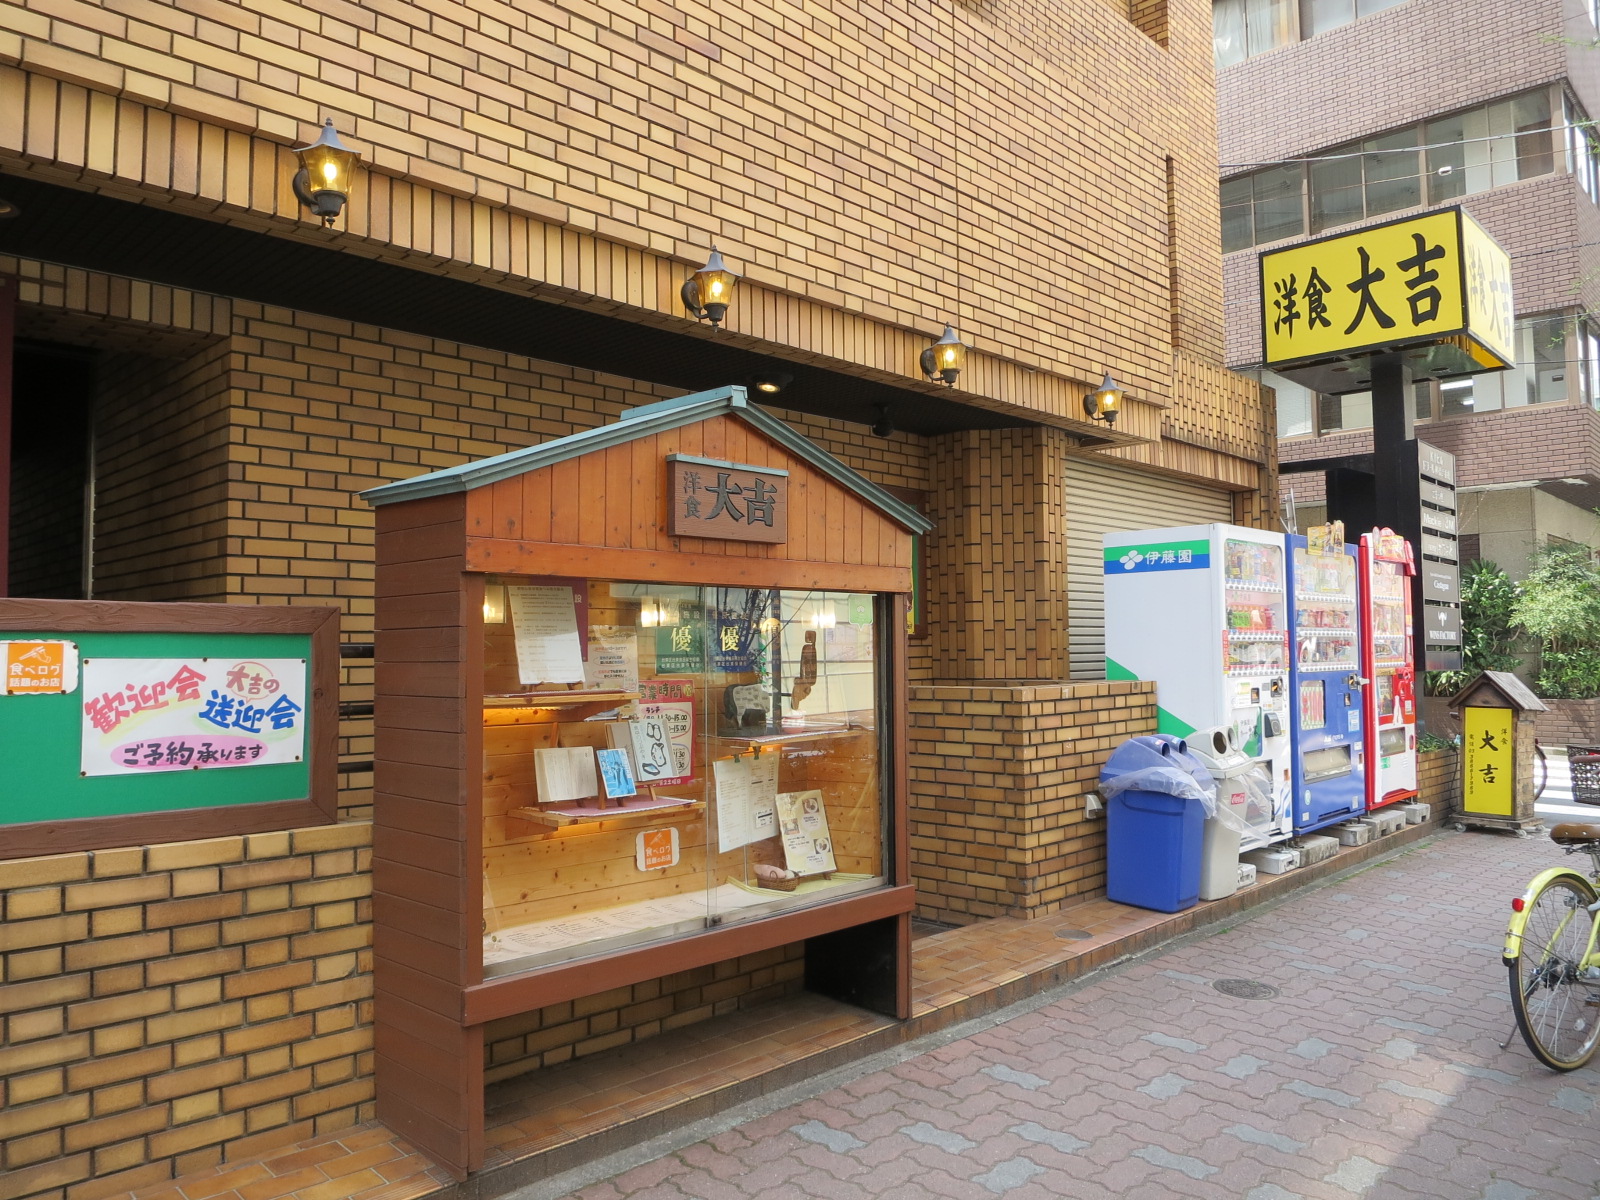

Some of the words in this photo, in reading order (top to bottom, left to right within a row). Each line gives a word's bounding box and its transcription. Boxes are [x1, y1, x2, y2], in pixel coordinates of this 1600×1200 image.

[1273, 266, 1333, 340] 洋食
[1343, 232, 1446, 335] 大吉
[683, 470, 702, 519] 洋食
[704, 472, 778, 527] 大吉
[1145, 549, 1192, 566] 伊藤園
[670, 625, 692, 652] 優
[720, 625, 740, 652] 優
[9, 662, 62, 676] 食べログ
[9, 677, 61, 687] 話題のお店
[226, 665, 280, 695] 大吉の
[84, 664, 207, 735] 歓迎会
[198, 689, 302, 734] 送迎会
[645, 706, 660, 714] ランチ
[1501, 728, 1508, 745] 洋食
[123, 741, 263, 766] ご予約承ります
[1479, 730, 1499, 784] 大吉
[645, 846, 671, 856] 食べログ
